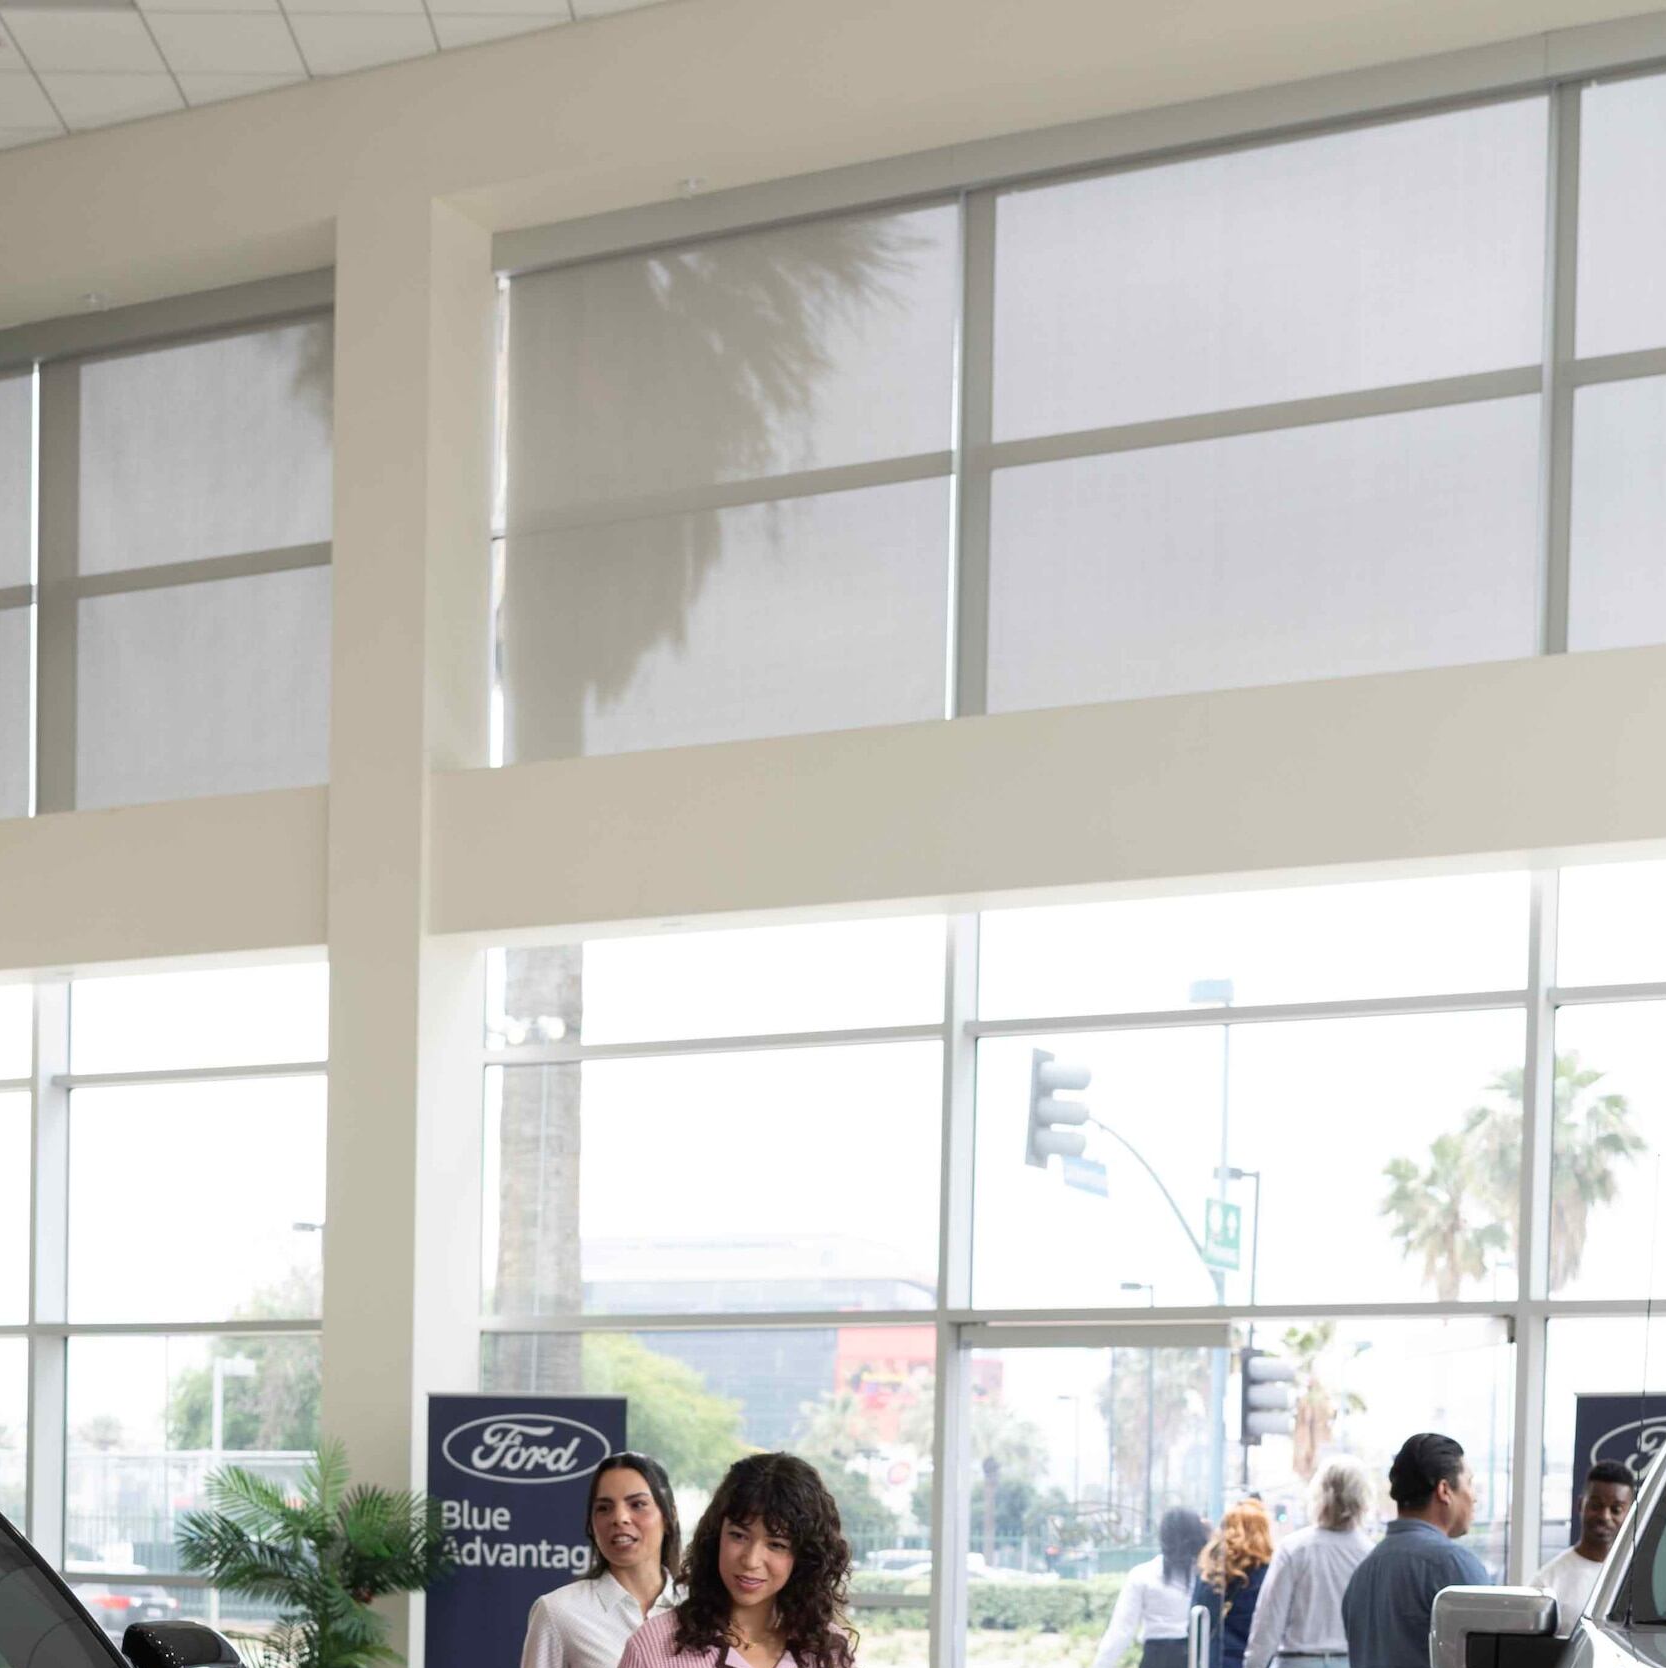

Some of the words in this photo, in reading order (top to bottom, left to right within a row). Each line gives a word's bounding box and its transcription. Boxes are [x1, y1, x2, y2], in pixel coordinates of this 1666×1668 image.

[471, 1422, 581, 1472] Ford
[441, 1499, 512, 1531] Blue
[440, 1535, 595, 1576] Advantag
